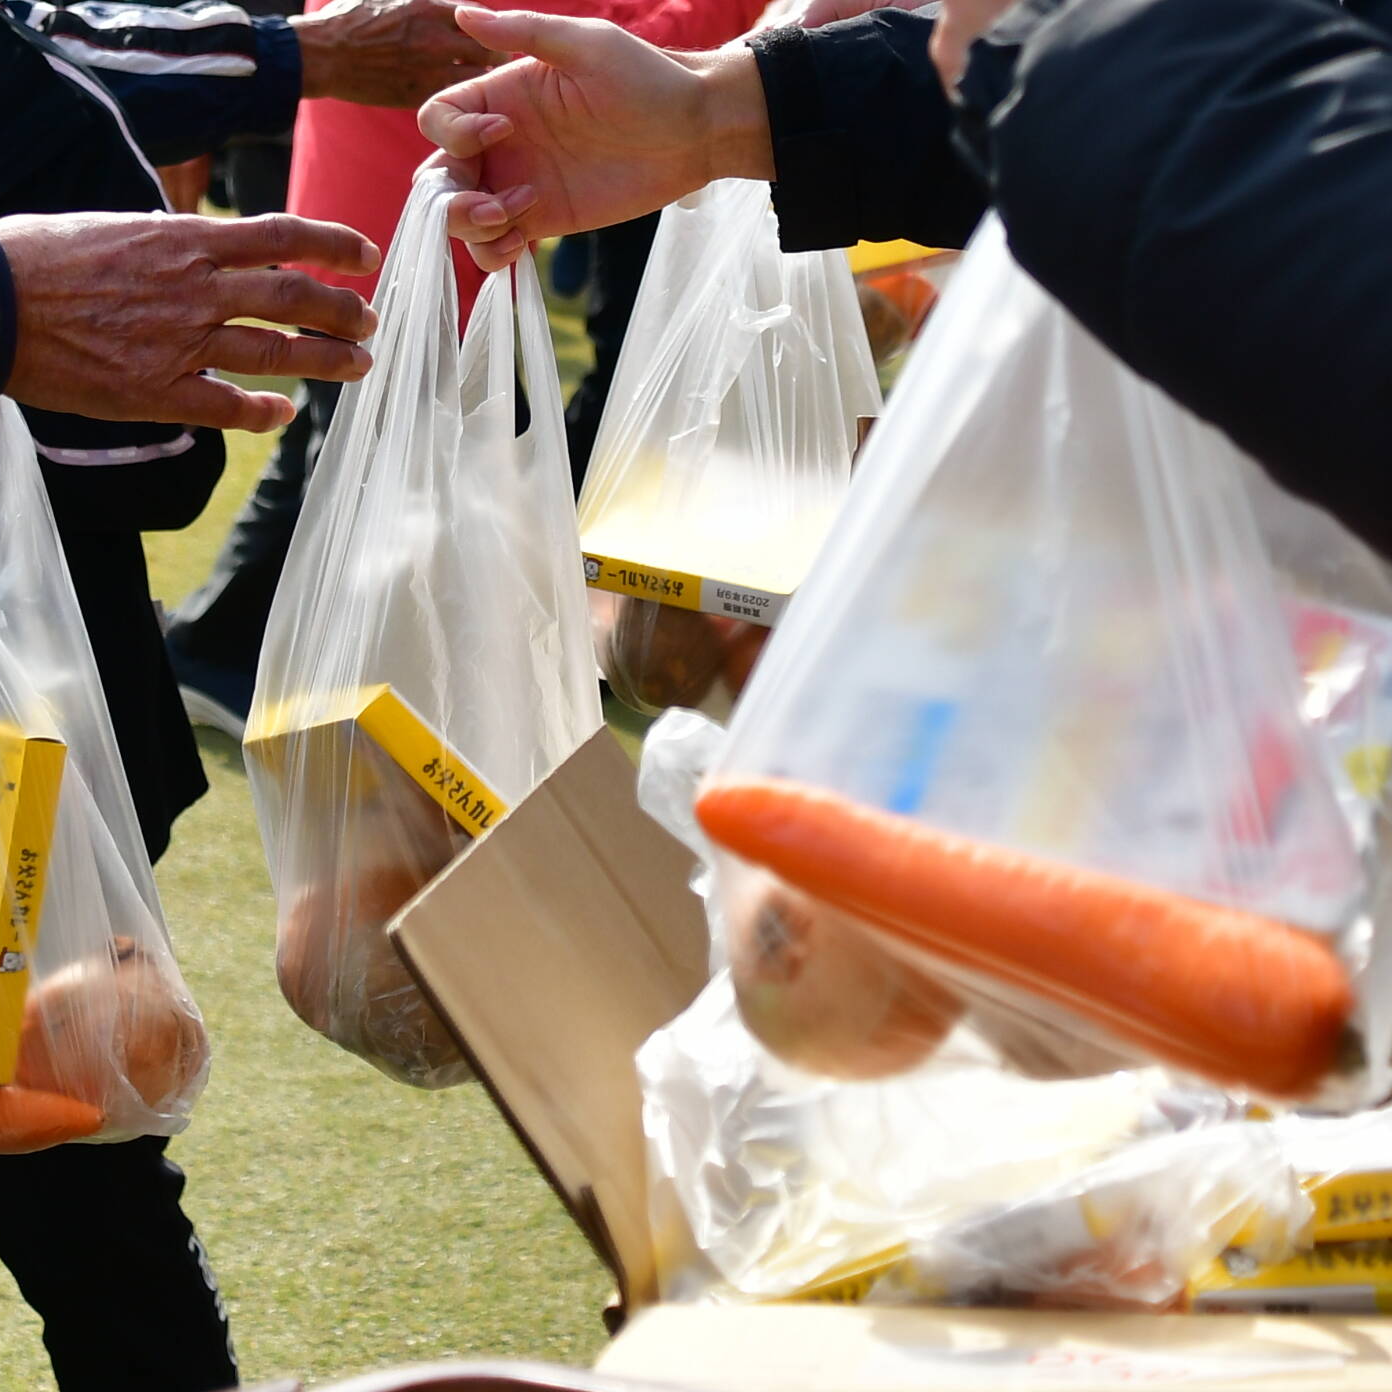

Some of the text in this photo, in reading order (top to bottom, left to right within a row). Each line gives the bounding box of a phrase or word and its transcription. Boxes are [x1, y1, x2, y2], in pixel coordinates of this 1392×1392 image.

[606, 569, 685, 597] お父さんカレー
[422, 758, 494, 829] お父さんカレ
[10, 848, 39, 943] お父さんカレー
